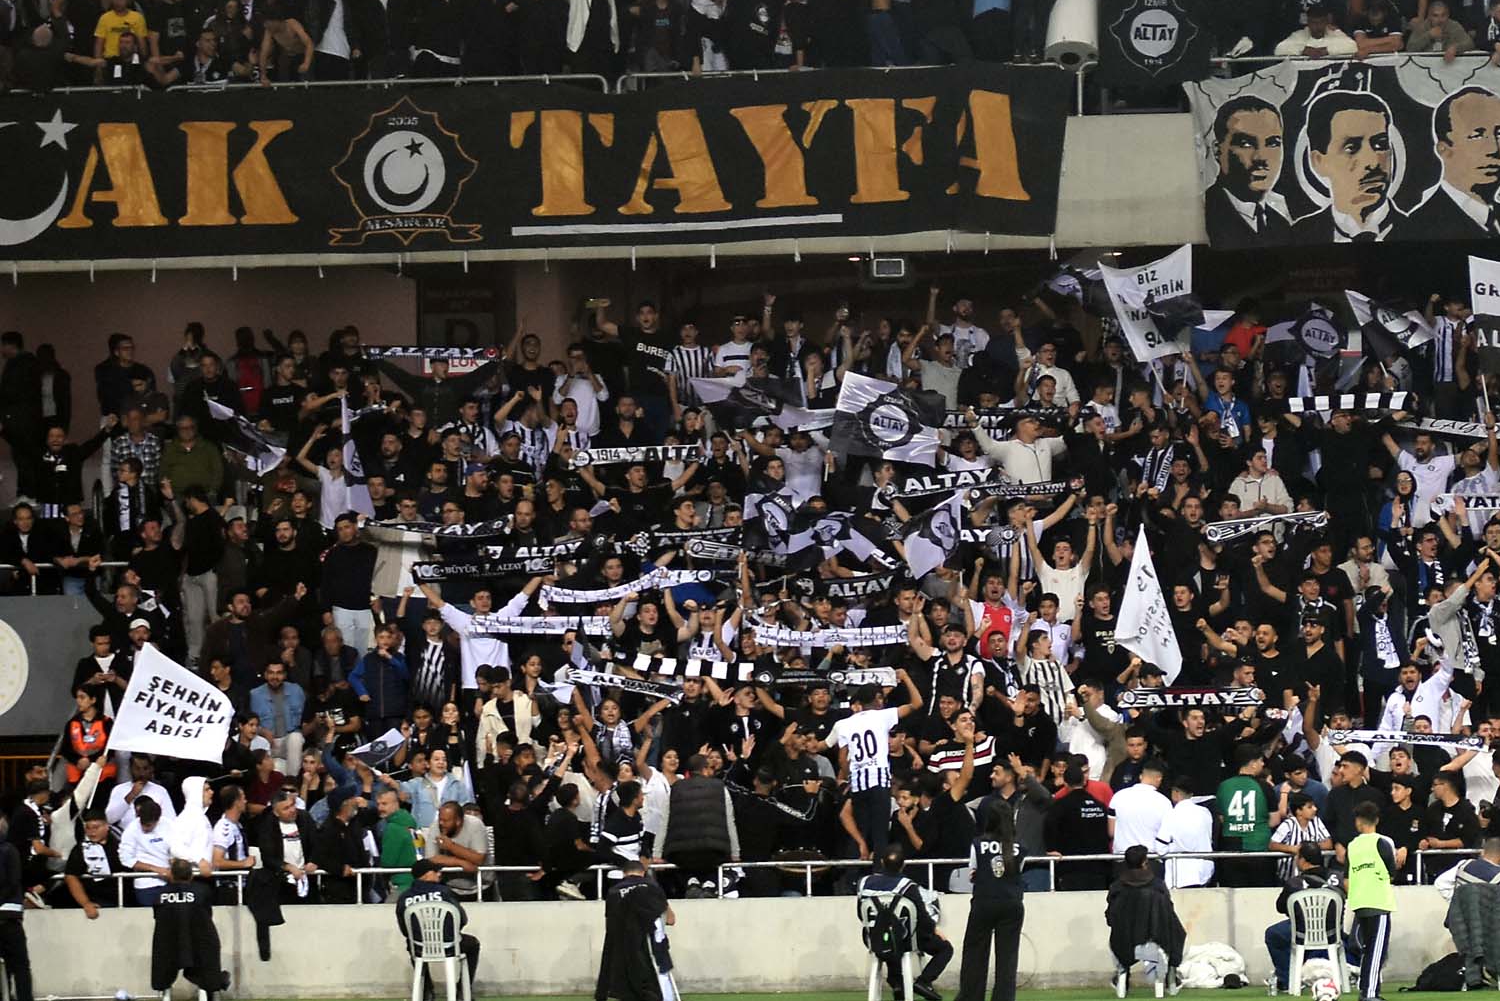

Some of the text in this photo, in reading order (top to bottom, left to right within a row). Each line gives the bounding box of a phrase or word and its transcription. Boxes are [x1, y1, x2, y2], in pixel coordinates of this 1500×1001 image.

[1134, 23, 1175, 41] ALTAY
[57, 90, 1031, 229] AK TAYFA
[1137, 268, 1158, 285] BİZ
[1304, 326, 1337, 346] ALTAY
[384, 346, 483, 358] ALTAY
[873, 415, 907, 433] ALTAY
[945, 413, 1003, 428] ALAY
[595, 445, 699, 463] 1914 ALTA
[905, 469, 993, 492] ALTAY
[516, 540, 581, 558] ALTAY
[444, 565, 480, 575] BÜYÜK
[497, 563, 522, 572] ALTAY
[829, 575, 895, 598] ALTAY
[150, 675, 223, 713] ŞEHRİN
[1146, 692, 1239, 706] ALTAY
[135, 690, 226, 725] FİYAKALI
[145, 718, 203, 740] ABİSİ
[851, 730, 878, 763] 30
[1228, 790, 1256, 820] 41
[1229, 822, 1256, 832] MERT
[160, 892, 195, 904] POLİS
[405, 891, 443, 907] POLİS
